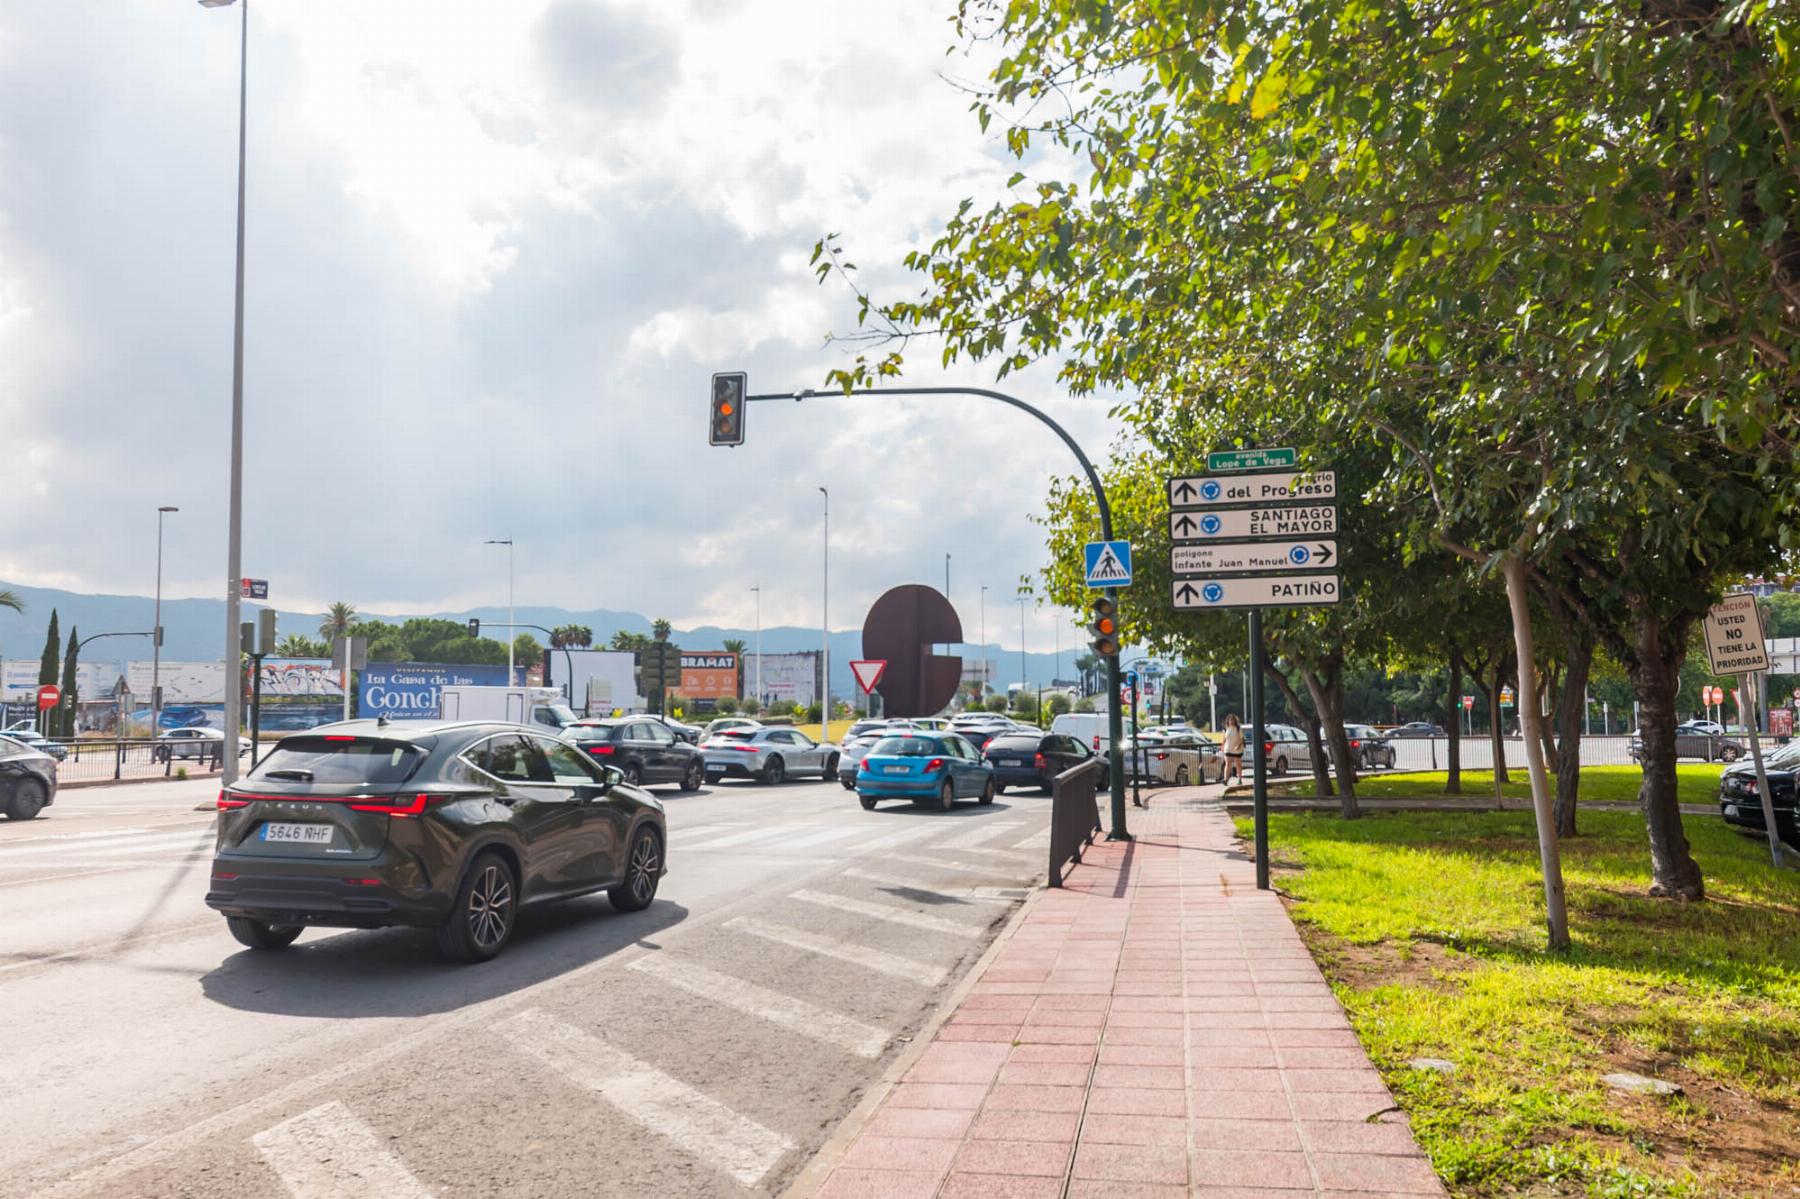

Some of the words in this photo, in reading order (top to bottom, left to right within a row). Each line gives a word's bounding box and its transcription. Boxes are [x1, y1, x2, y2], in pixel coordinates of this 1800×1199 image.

[1216, 460, 1240, 469] Lope
[1263, 457, 1287, 466] Vega
[1227, 486, 1251, 499] del
[1251, 507, 1333, 522] SANTIAGO
[1251, 523, 1268, 534] EL
[1278, 520, 1333, 533] MAYOR
[1218, 558, 1243, 568] Juan
[1250, 556, 1289, 566] Manuel
[1272, 581, 1335, 597] PATIÑO
[1711, 601, 1751, 613] TENCION
[1717, 615, 1745, 626] USTED
[1726, 628, 1742, 640] NO
[1718, 644, 1744, 655] TIENE
[1745, 642, 1757, 652] LA
[1716, 656, 1763, 669] PRIORIDAD
[391, 674, 426, 685] Casa
[430, 675, 448, 685] de
[269, 825, 300, 839] 5646
[304, 826, 330, 840] NHF
